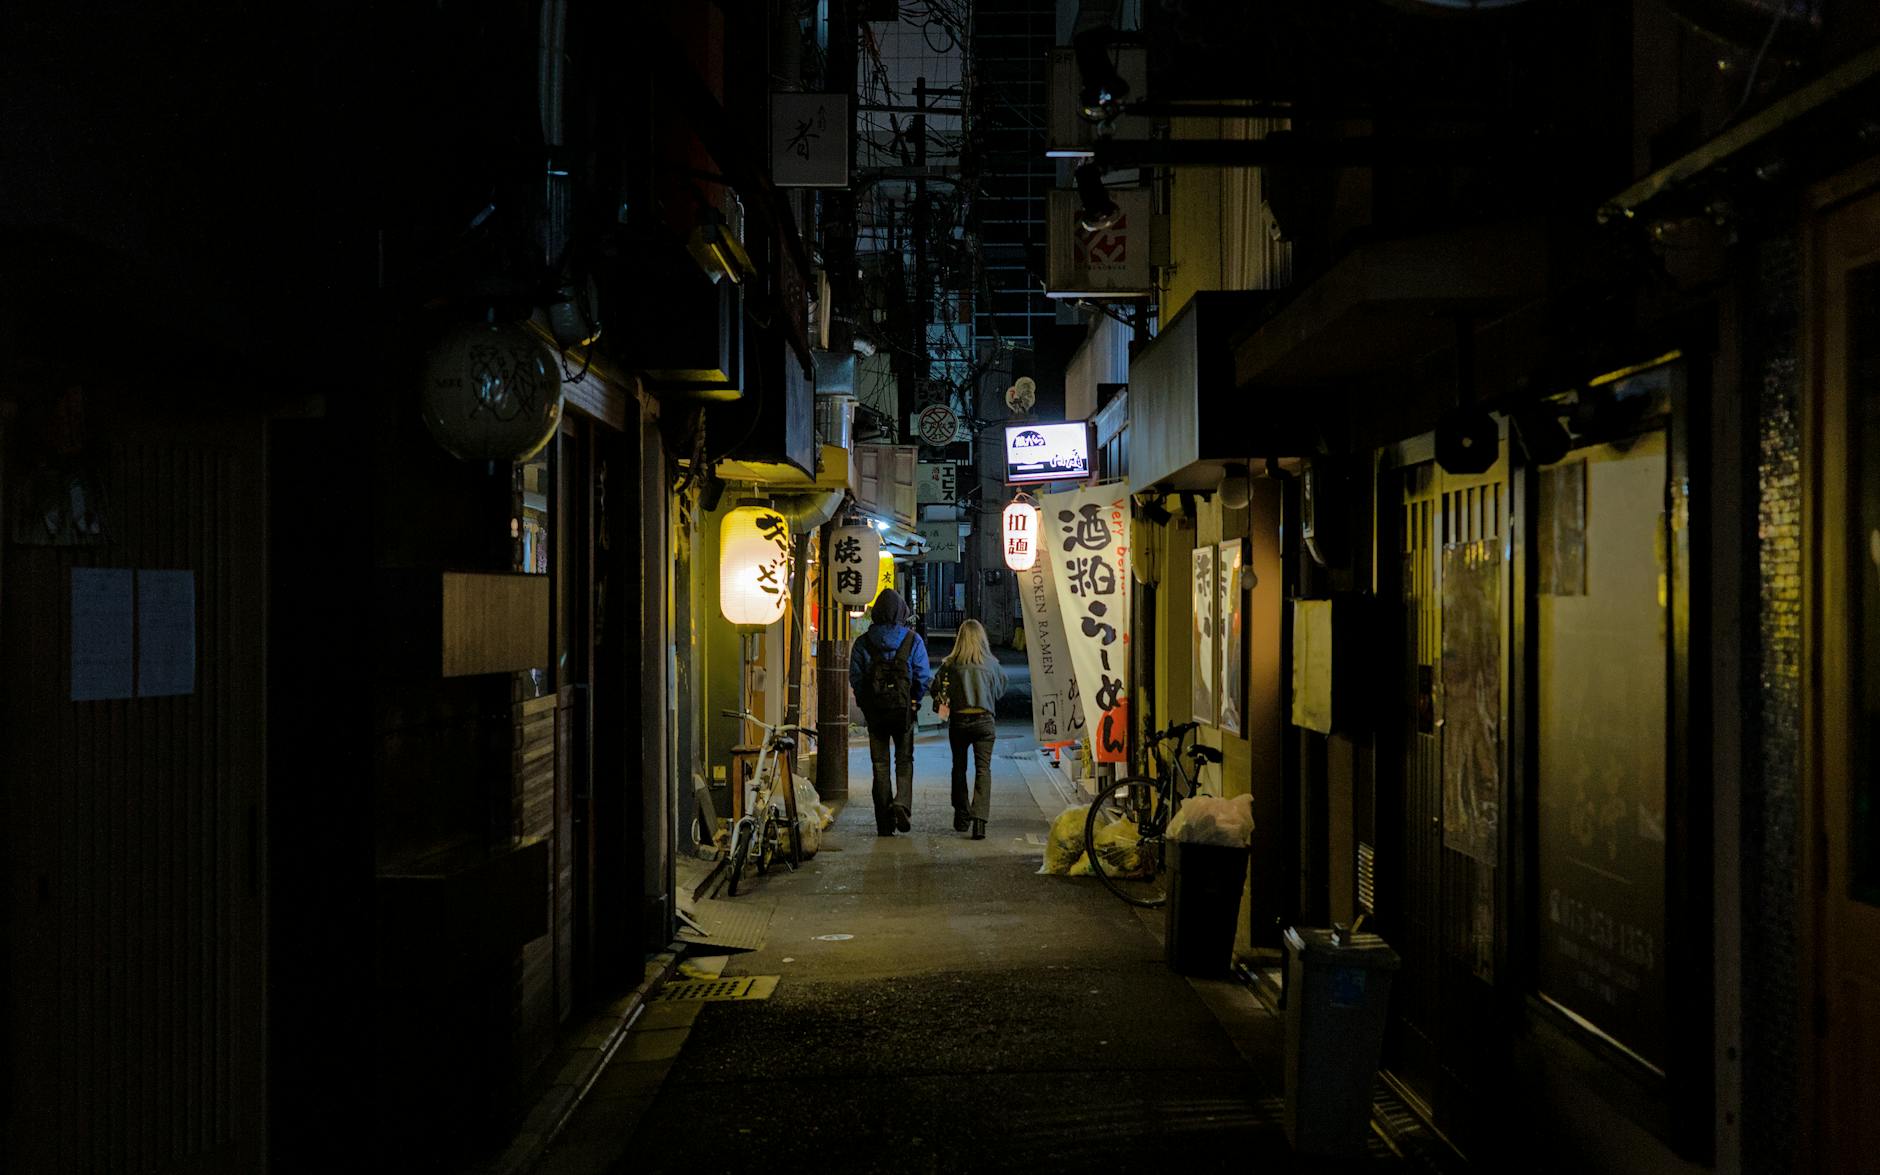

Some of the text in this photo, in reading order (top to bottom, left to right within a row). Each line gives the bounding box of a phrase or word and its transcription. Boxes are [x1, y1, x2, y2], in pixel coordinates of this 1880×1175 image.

[942, 467, 955, 501] エビス
[834, 536, 863, 595] 焼肉
[1038, 620, 1054, 675] RA-MEN
[1058, 503, 1125, 753] 酒粕らーめん
